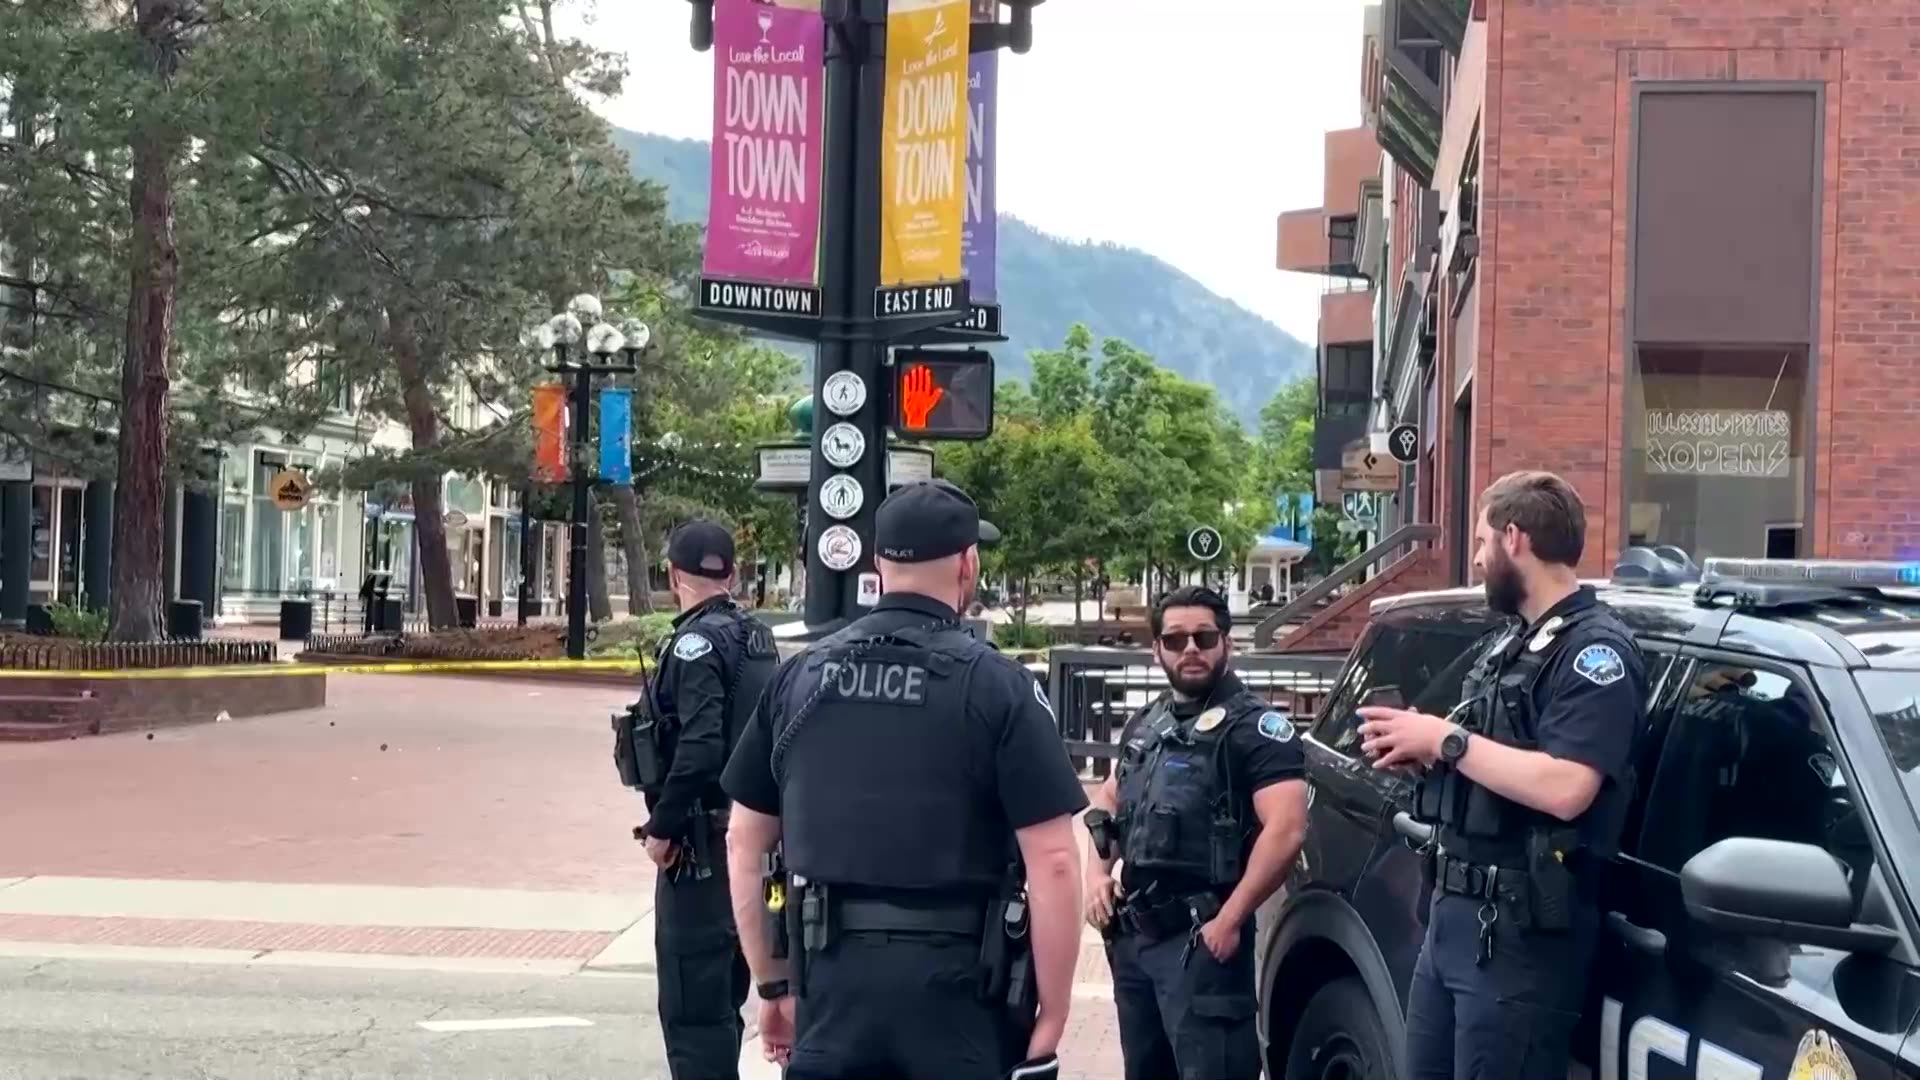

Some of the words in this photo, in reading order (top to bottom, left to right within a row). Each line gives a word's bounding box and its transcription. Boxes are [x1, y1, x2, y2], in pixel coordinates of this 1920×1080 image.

[729, 45, 752, 63] Love
[753, 45, 769, 64] the
[771, 44, 805, 63] Local
[903, 58, 925, 75] Love
[726, 66, 808, 136] DOWN
[897, 70, 959, 138] DOWN
[724, 132, 806, 204] TOWN
[895, 136, 956, 206] TOWN
[709, 282, 812, 312] DOWNTOWN
[884, 289, 918, 313] EAST
[925, 286, 953, 310] END
[1668, 441, 1764, 474] OPEN
[821, 661, 925, 700] POLICE
